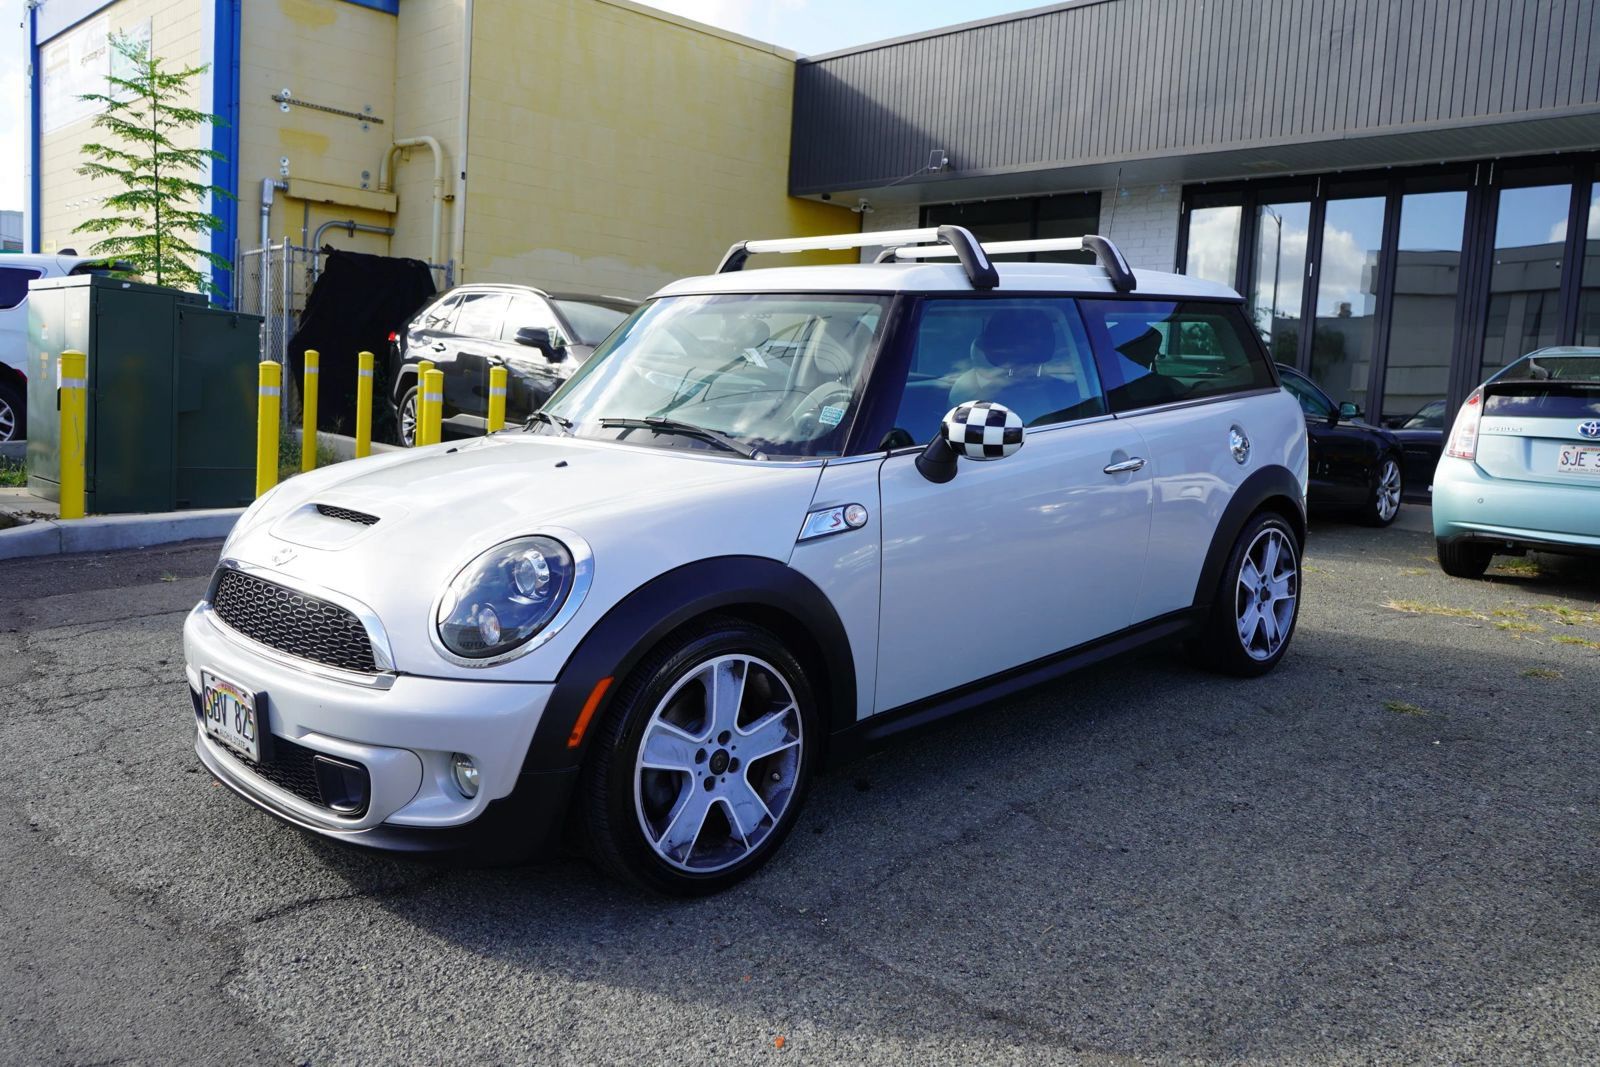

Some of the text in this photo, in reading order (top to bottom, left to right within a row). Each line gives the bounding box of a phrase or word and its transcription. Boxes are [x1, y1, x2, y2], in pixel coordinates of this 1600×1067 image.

[1561, 451, 1588, 467] SJE
[206, 685, 255, 742] SBV 825
